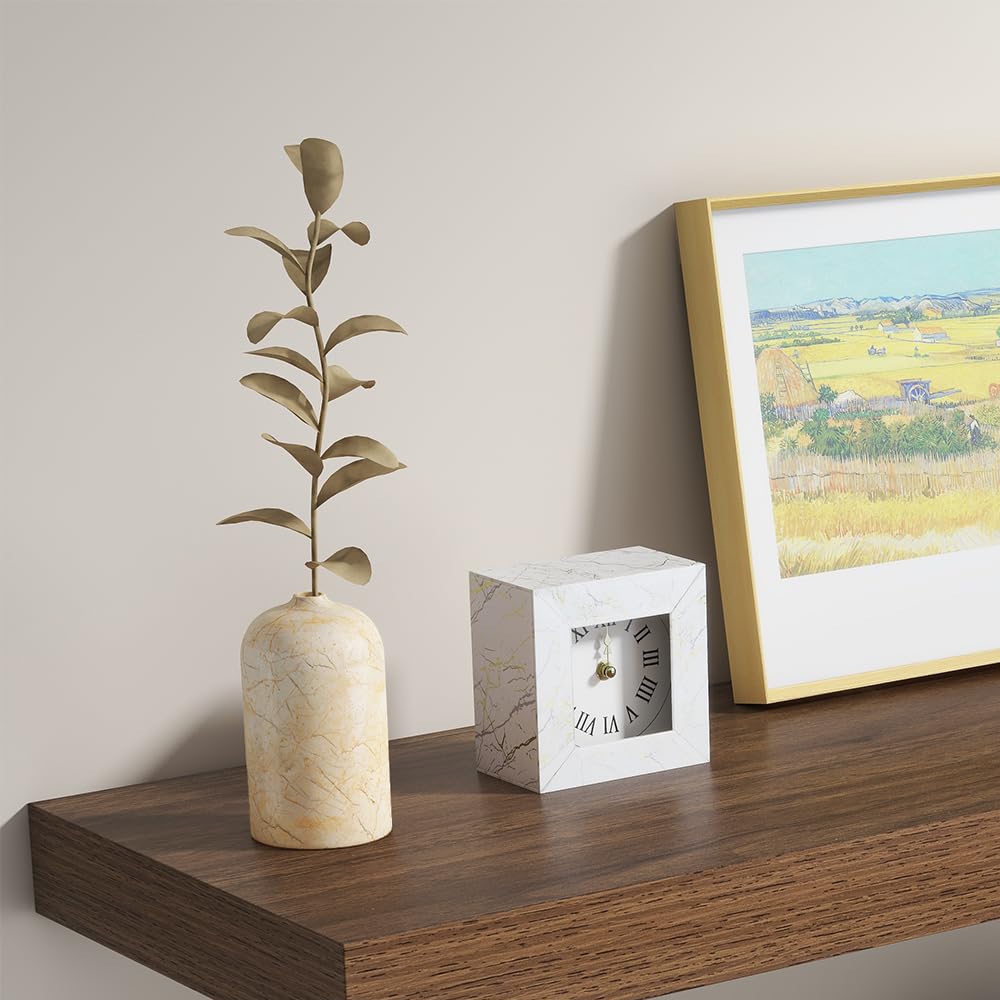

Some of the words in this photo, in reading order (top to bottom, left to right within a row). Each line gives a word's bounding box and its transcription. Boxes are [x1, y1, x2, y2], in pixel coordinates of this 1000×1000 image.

[633, 624, 651, 643] II
[642, 648, 660, 668] III
[635, 675, 658, 704] IIII
[575, 711, 596, 736] VII
[603, 714, 620, 734] VI
[625, 705, 640, 723] V
